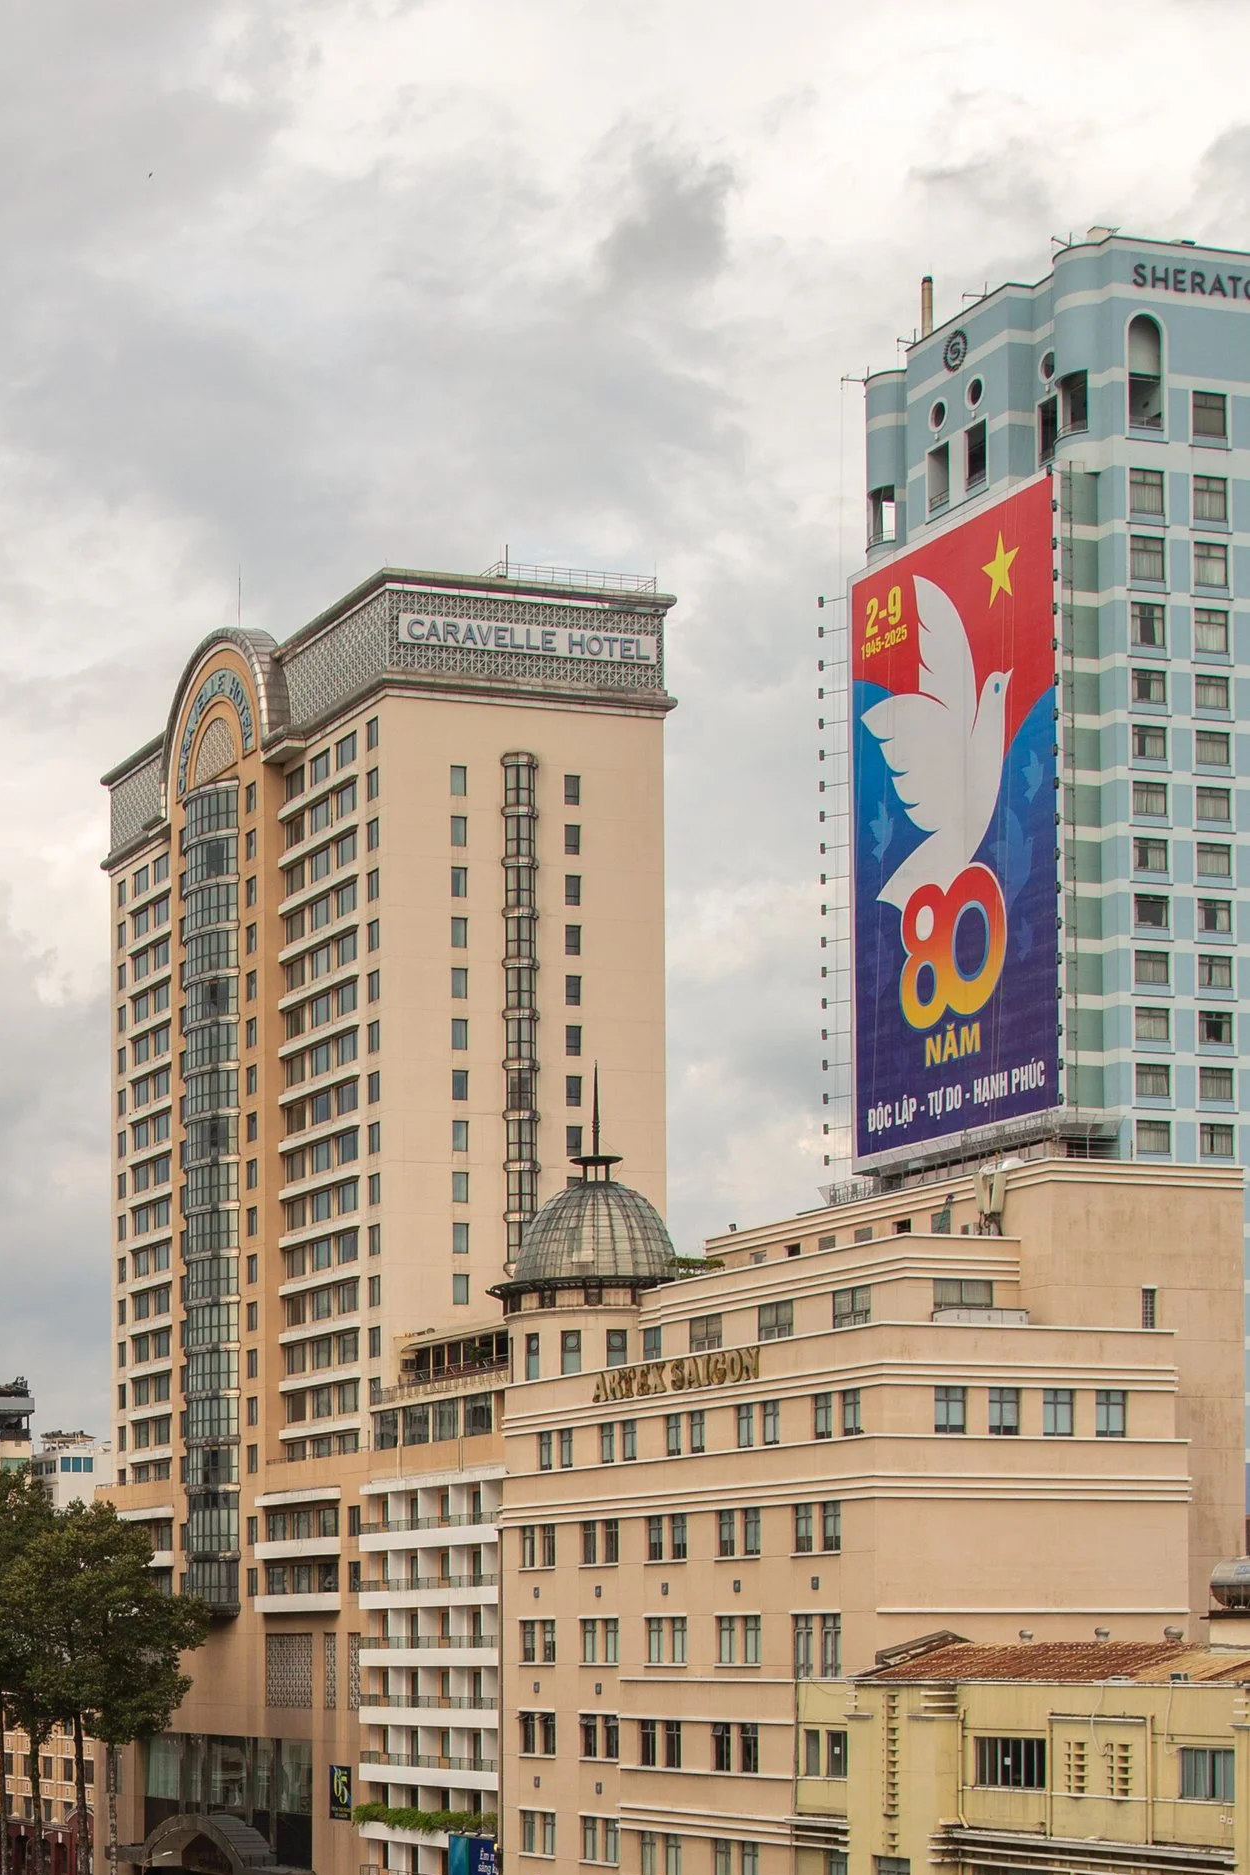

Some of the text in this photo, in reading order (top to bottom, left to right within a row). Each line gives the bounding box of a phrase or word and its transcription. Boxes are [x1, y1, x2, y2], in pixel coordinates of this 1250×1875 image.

[1132, 263, 1250, 300] SHERAT
[865, 586, 902, 638] 2-9
[407, 618, 650, 660] CARAVELLE HOTEL
[861, 624, 908, 660] 1945-2025
[901, 862, 1007, 1032] 80
[924, 1018, 981, 1067] NĂM
[868, 1101, 892, 1135] ĐỘC
[895, 1094, 917, 1128] LẬP
[928, 1087, 944, 1120] TỰ
[946, 1084, 962, 1112] DO
[973, 1071, 1008, 1107] HẠNH
[1012, 1058, 1045, 1094] PHÚC
[592, 1346, 761, 1403] ARTEX SAIGON
